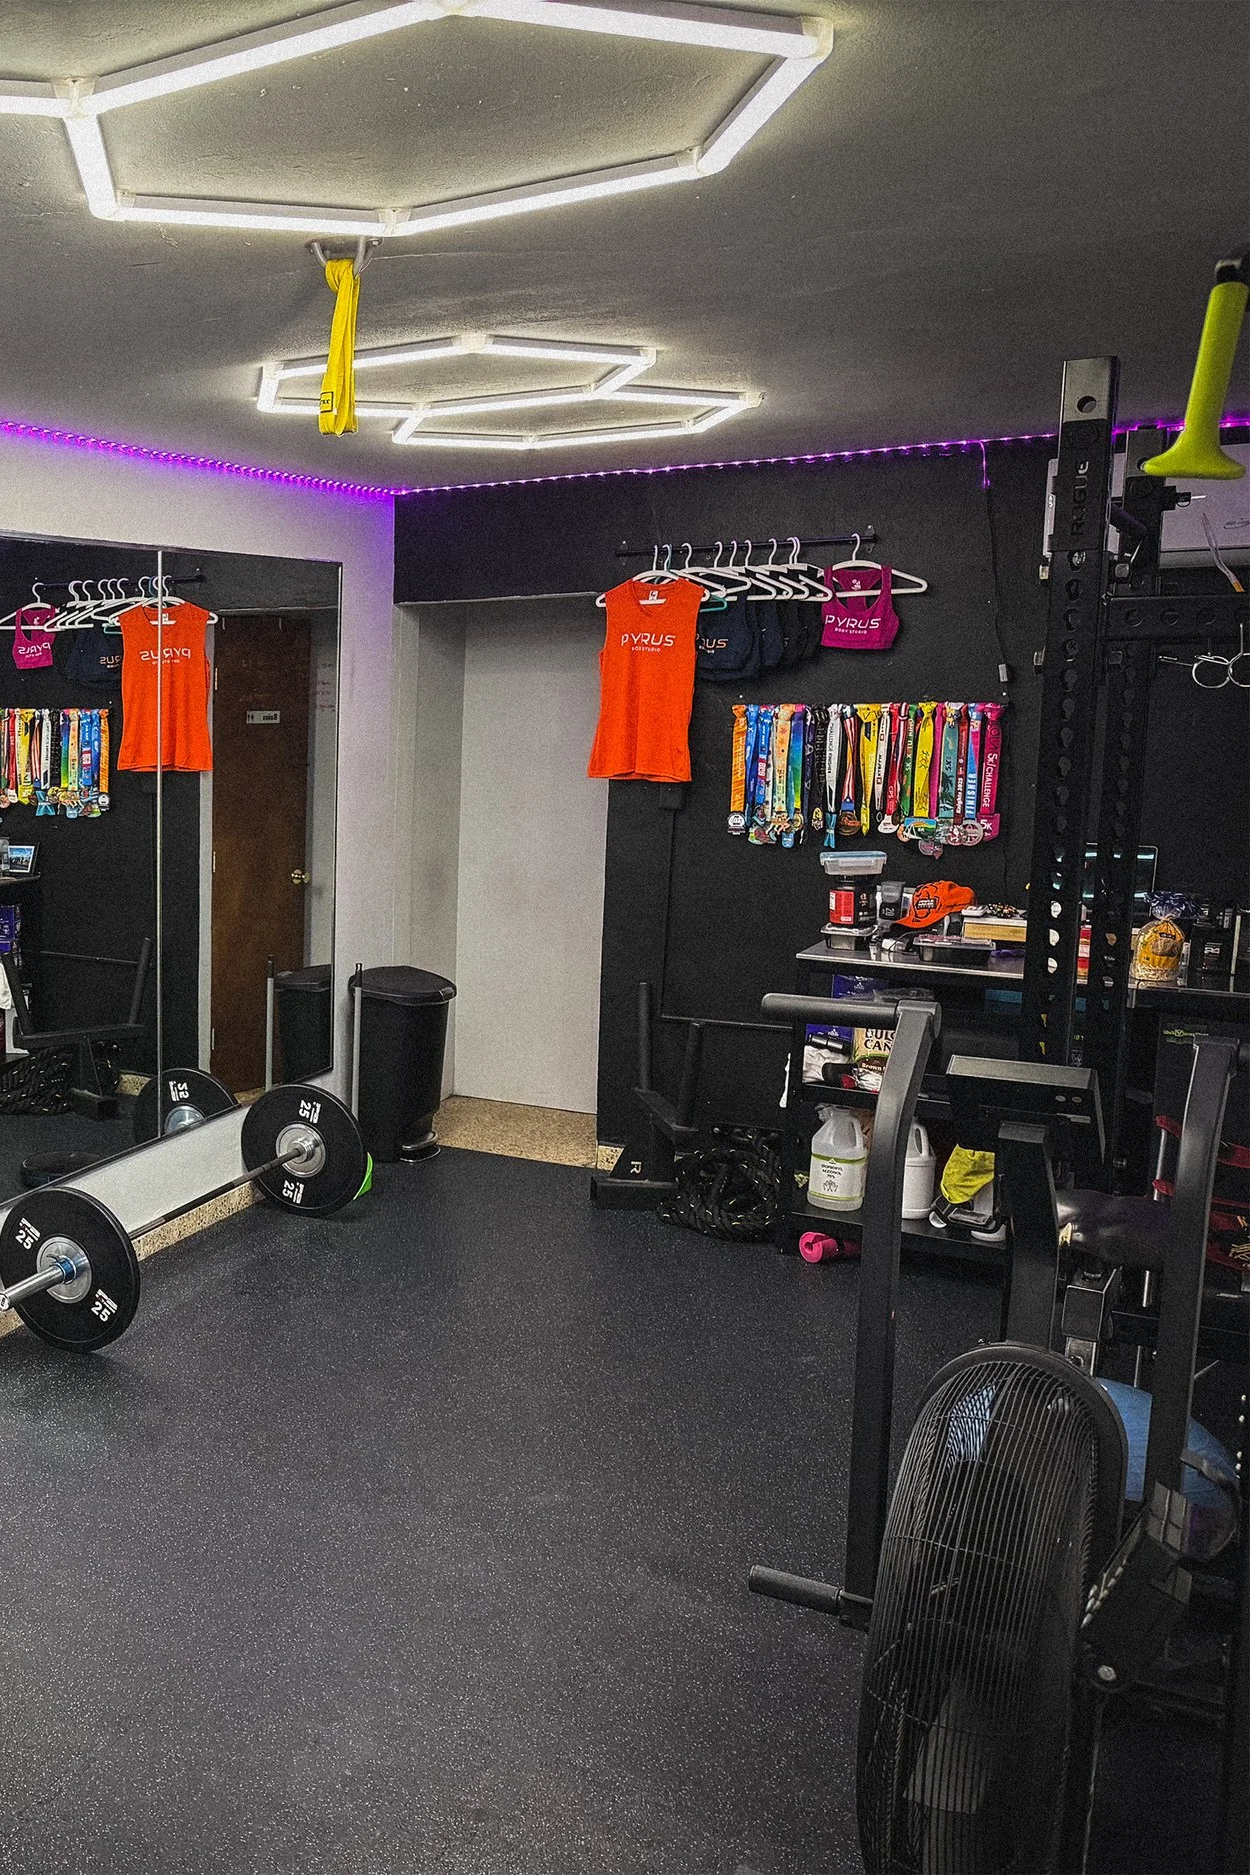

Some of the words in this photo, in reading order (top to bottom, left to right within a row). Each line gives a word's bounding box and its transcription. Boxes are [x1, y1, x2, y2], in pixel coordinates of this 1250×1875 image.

[1069, 460, 1090, 537] ROGUE
[825, 615, 881, 629] PYRUS
[621, 632, 676, 647] PYRUS
[965, 773, 977, 814] FINISHER
[298, 1100, 310, 1119] 25
[282, 1180, 294, 1199] 25
[15, 1229, 34, 1250] 25
[90, 1300, 111, 1322] 25
